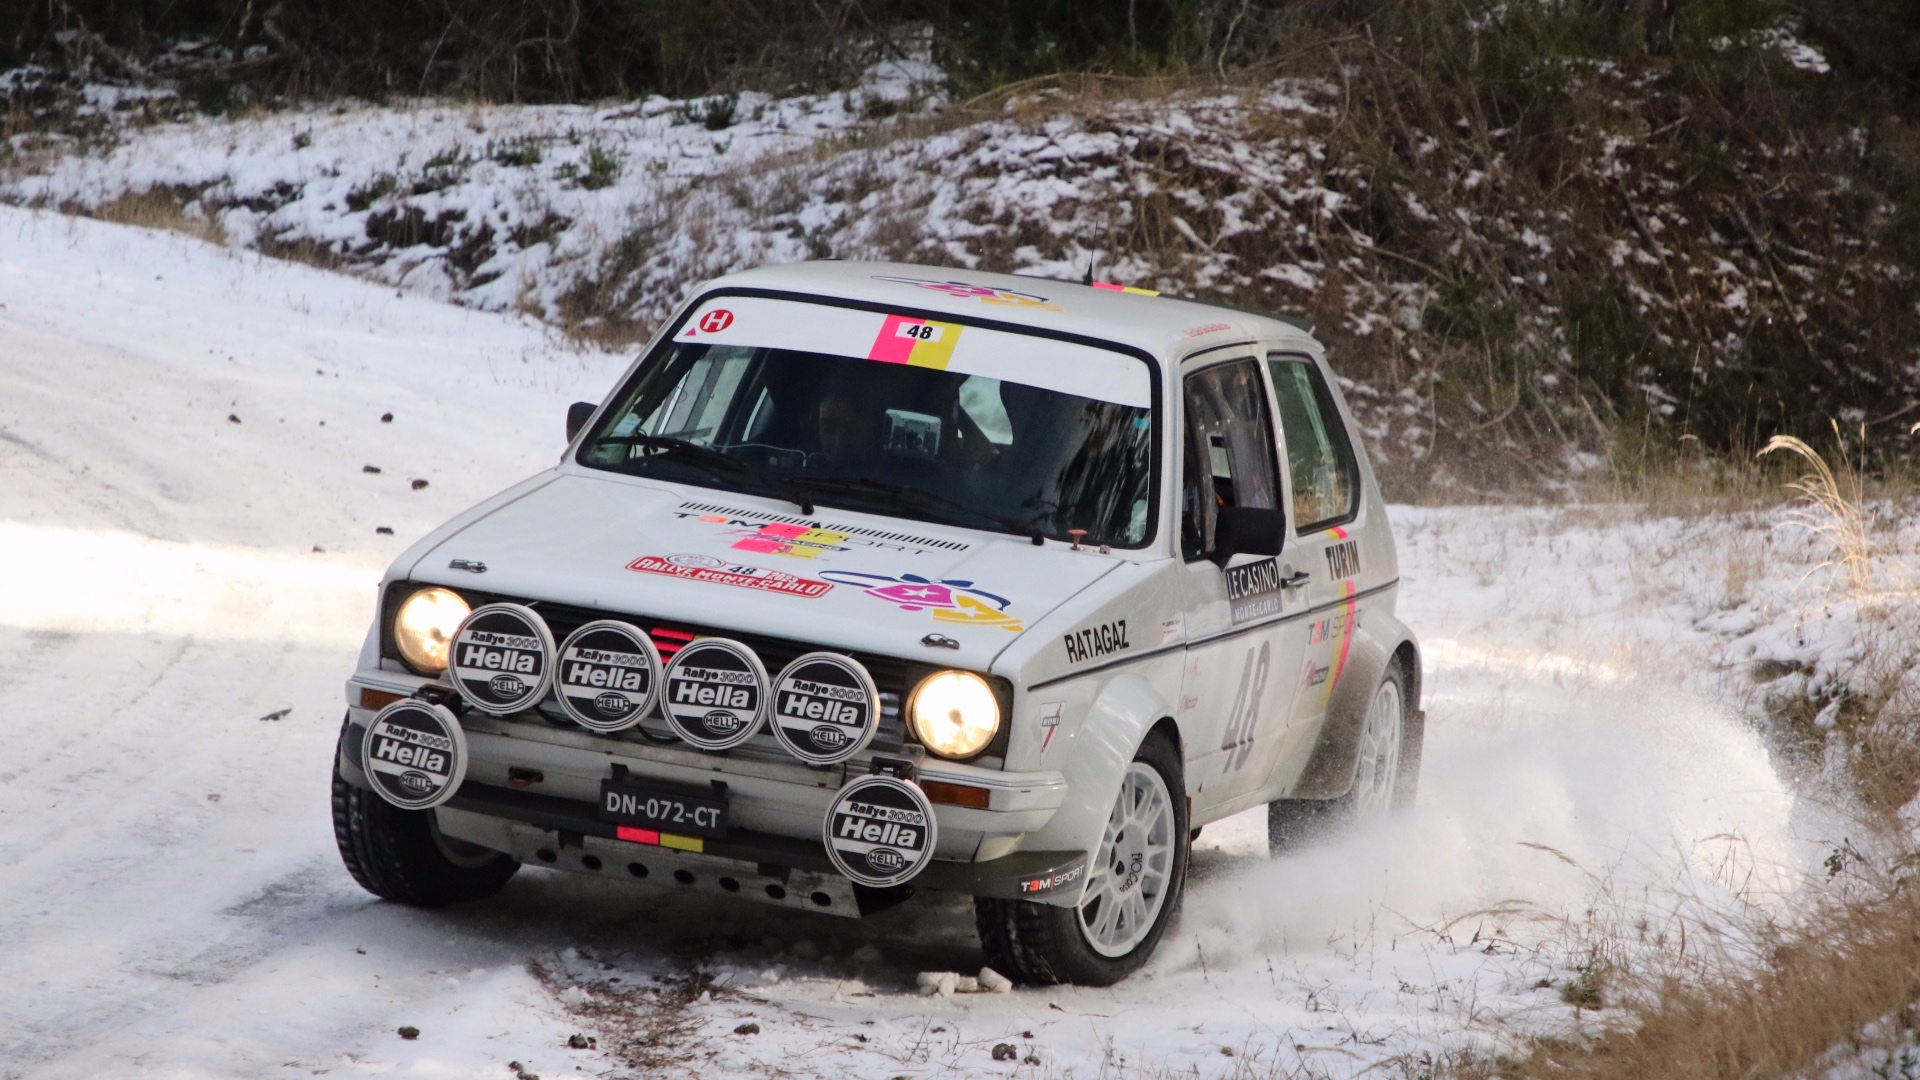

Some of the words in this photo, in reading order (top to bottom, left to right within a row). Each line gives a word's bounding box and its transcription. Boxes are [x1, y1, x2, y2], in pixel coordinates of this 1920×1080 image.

[703, 312, 730, 330] H
[906, 325, 934, 339] 48
[1325, 540, 1360, 581] TURIN
[635, 558, 696, 575] RALLYE
[694, 570, 823, 595] MONTE-CARLO
[728, 566, 757, 575] 48
[764, 571, 799, 583] 2023
[1226, 570, 1240, 600] LE
[1239, 561, 1278, 597] CASINO
[470, 632, 506, 645] Rallye
[506, 636, 540, 649] 3000
[1064, 620, 1130, 663] RATAGAZ
[1308, 616, 1331, 646] T3M
[463, 645, 535, 673] Hella
[576, 648, 611, 663] Rallye
[612, 653, 647, 667] 3000
[491, 680, 525, 693] HELLA
[568, 663, 641, 690] Hella
[682, 667, 719, 681] Rallye
[719, 671, 754, 684] 3000
[675, 681, 750, 708] Hella
[792, 680, 829, 695] Rallye
[829, 687, 865, 701] 3000
[596, 698, 631, 711] HELLA
[784, 693, 858, 725] Hella
[1221, 640, 1271, 774] 48
[705, 716, 740, 729] HELLA
[385, 724, 418, 740] Rallye
[418, 734, 450, 749] 3000
[812, 731, 847, 745] HELLA
[377, 738, 445, 772] Hella
[401, 776, 433, 792] HELLA
[606, 792, 720, 828] DN-072-CT
[849, 802, 887, 818] Rallye
[888, 810, 923, 824] 3000
[840, 816, 917, 848] Hella
[869, 853, 903, 868] HELLA
